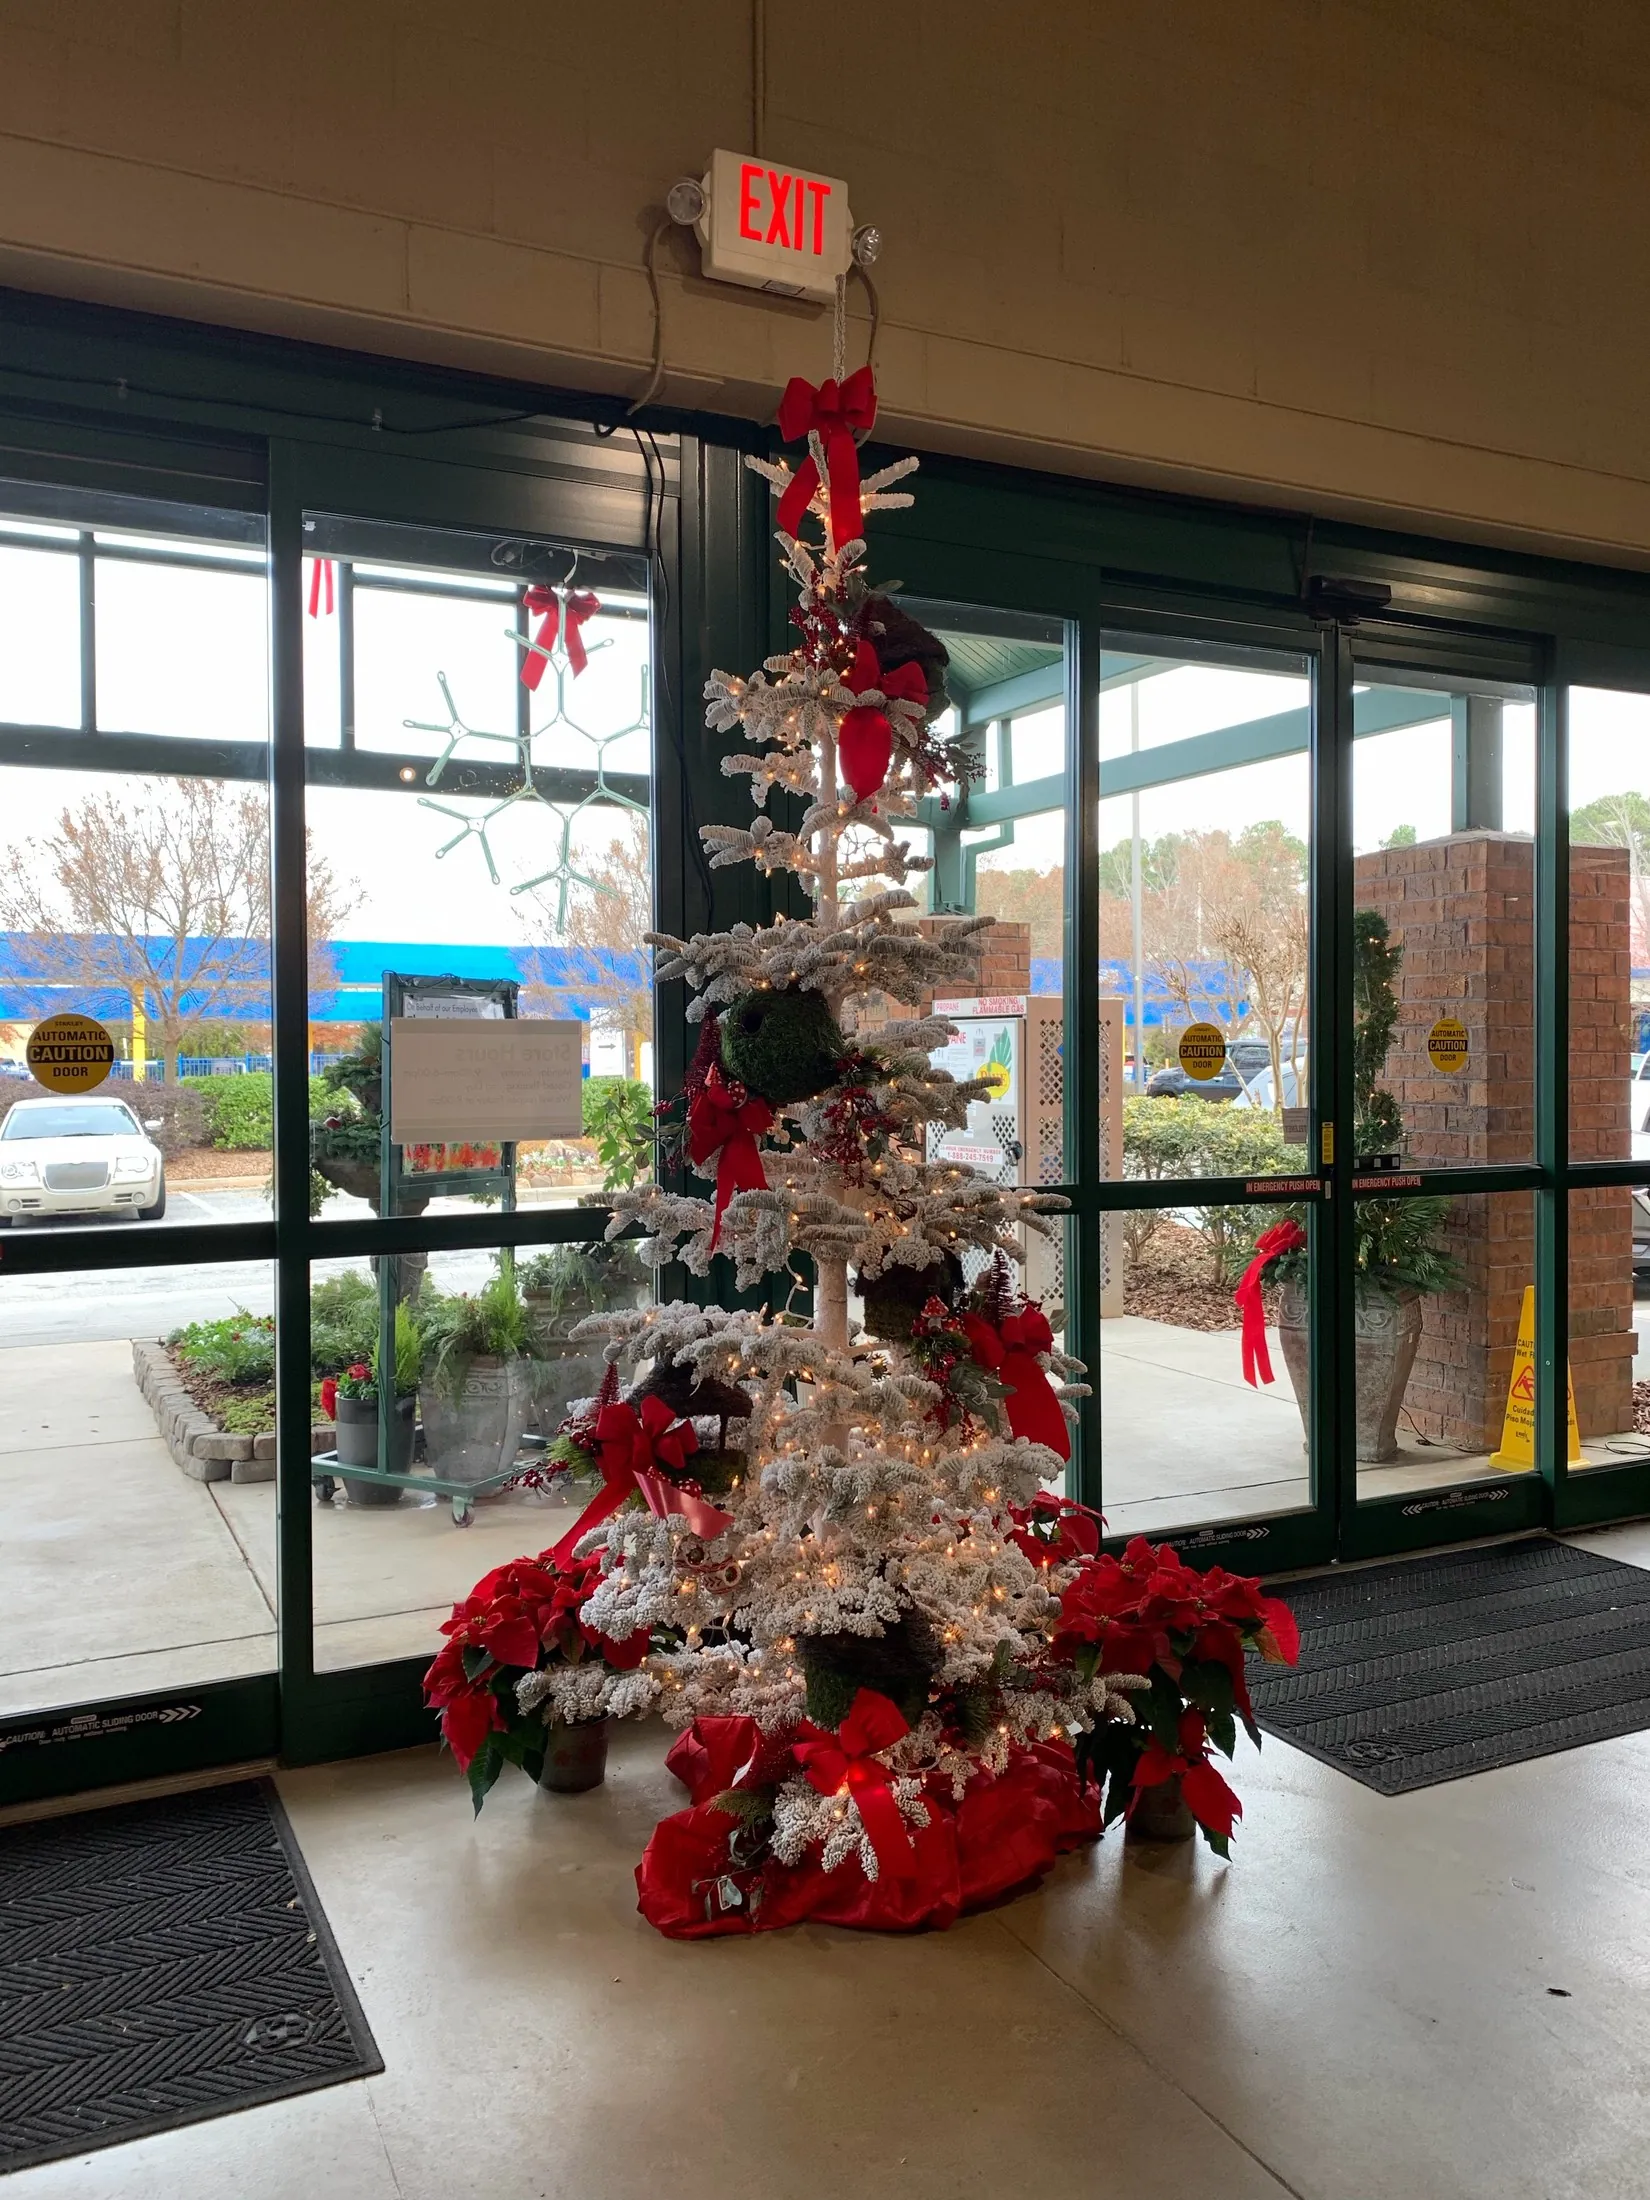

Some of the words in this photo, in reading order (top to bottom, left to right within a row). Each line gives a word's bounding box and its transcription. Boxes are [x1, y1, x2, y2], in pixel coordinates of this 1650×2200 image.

[740, 163, 832, 256] EXIT
[978, 998, 987, 1006] NO
[989, 996, 1018, 1005] SMOKING
[416, 1003, 434, 1011] Behalf
[435, 1004, 441, 1012] of
[936, 1002, 960, 1012] PROPANE
[973, 1005, 1010, 1014] FLAMMABLE
[1011, 1004, 1025, 1013] GAS
[34, 1031, 106, 1041] AUTOMATIC
[1430, 1040, 1465, 1050] CAUTION
[30, 1046, 108, 1060] CAUTION
[1180, 1046, 1223, 1057] CAUTION
[53, 1066, 88, 1077] DOOR
[1254, 1181, 1288, 1192] EMERGENCY
[1289, 1181, 1304, 1191] PUSH
[1305, 1180, 1321, 1191] OPEN
[1359, 1177, 1392, 1188] EMERGENCY
[1393, 1176, 1406, 1187] PUSH
[1407, 1176, 1421, 1187] OPEN
[1517, 1339, 1534, 1349] CAUT
[1189, 1534, 1215, 1544] AUTOMATIC
[1216, 1532, 1234, 1541] SLIDING
[1234, 1530, 1247, 1538] DOOR
[52, 1721, 100, 1737] AUTOMATIC
[101, 1714, 133, 1728] SLIDING
[135, 1710, 158, 1722] DOOR
